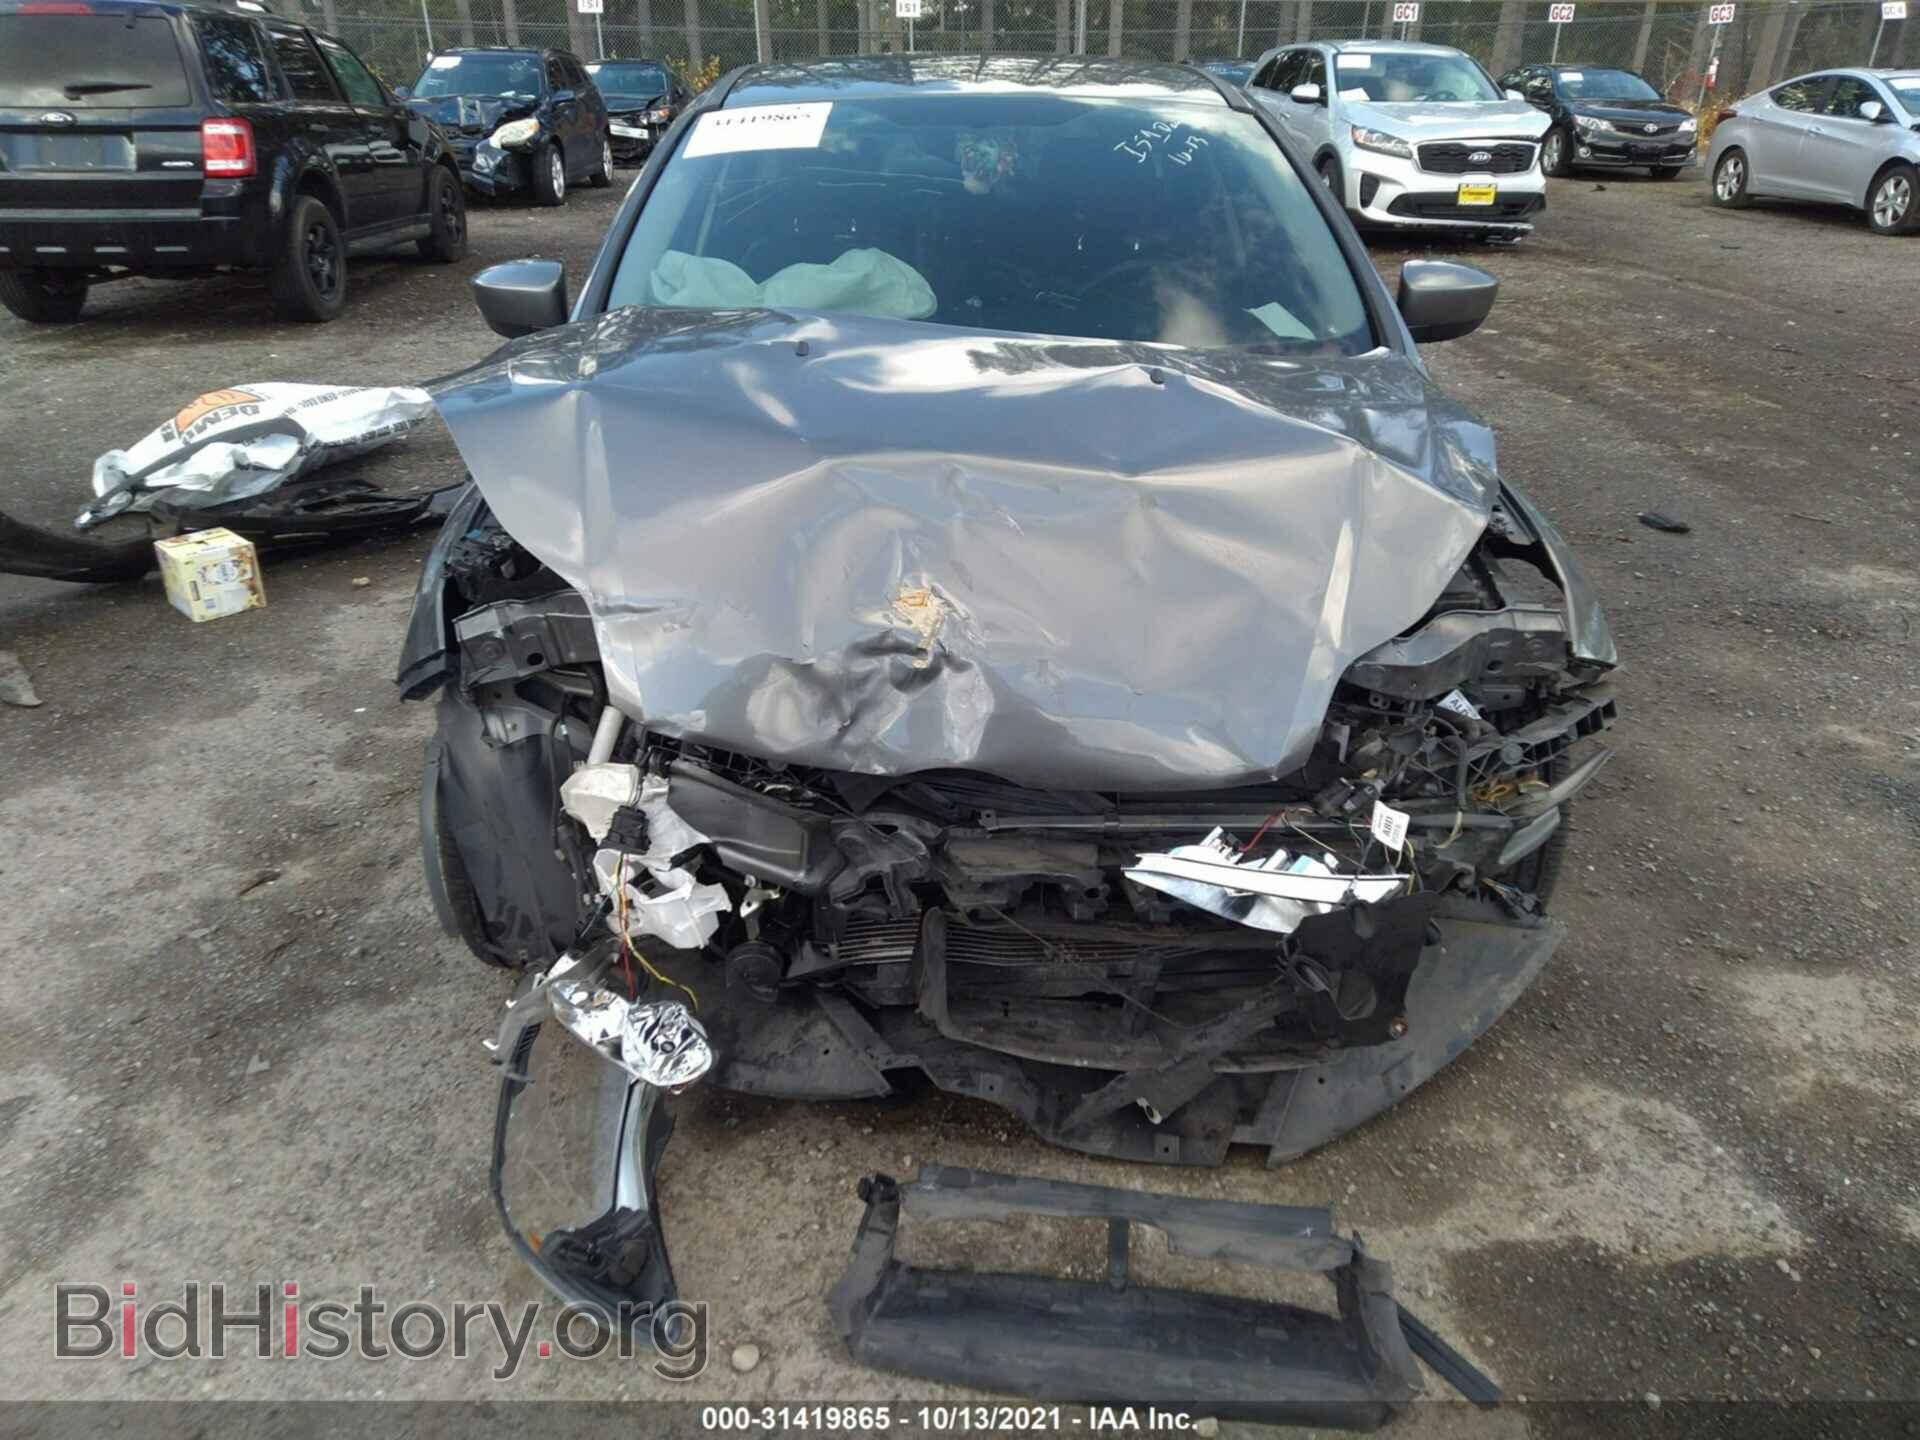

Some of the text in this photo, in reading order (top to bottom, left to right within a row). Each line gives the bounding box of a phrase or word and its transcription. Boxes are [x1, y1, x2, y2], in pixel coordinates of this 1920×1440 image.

[1395, 4, 1417, 20] GC1
[1551, 5, 1573, 20] GC2
[1711, 5, 1733, 22] GC3
